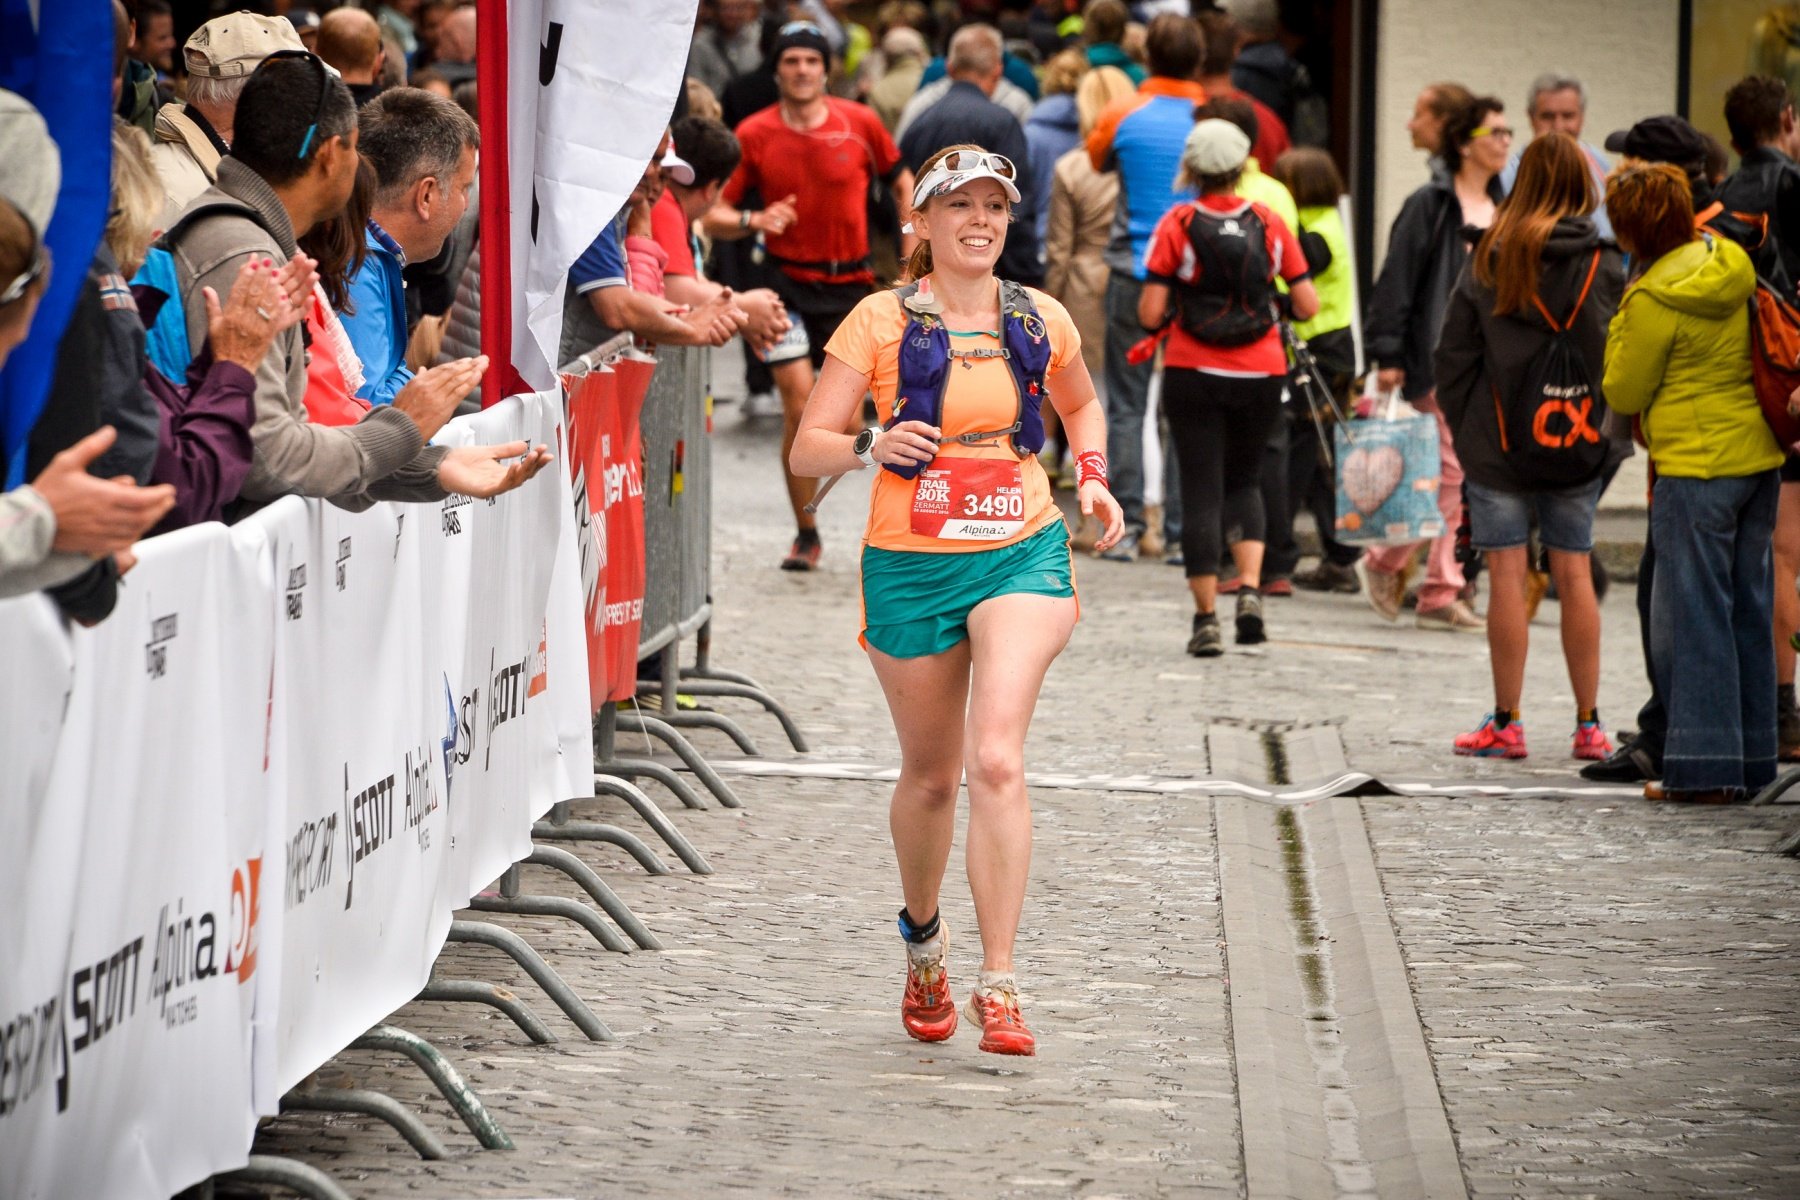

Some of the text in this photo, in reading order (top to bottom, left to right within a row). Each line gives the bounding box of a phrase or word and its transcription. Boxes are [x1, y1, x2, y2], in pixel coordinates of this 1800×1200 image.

[1532, 396, 1600, 448] CX
[919, 479, 951, 490] TRAIL
[996, 486, 1022, 495] HELEN
[915, 489, 951, 503] 30K
[913, 502, 950, 510] ZERMATT
[963, 494, 1023, 517] 3490
[958, 524, 998, 536] Alpina
[353, 773, 396, 864] SCOTT
[71, 935, 144, 1054] SCOTT
